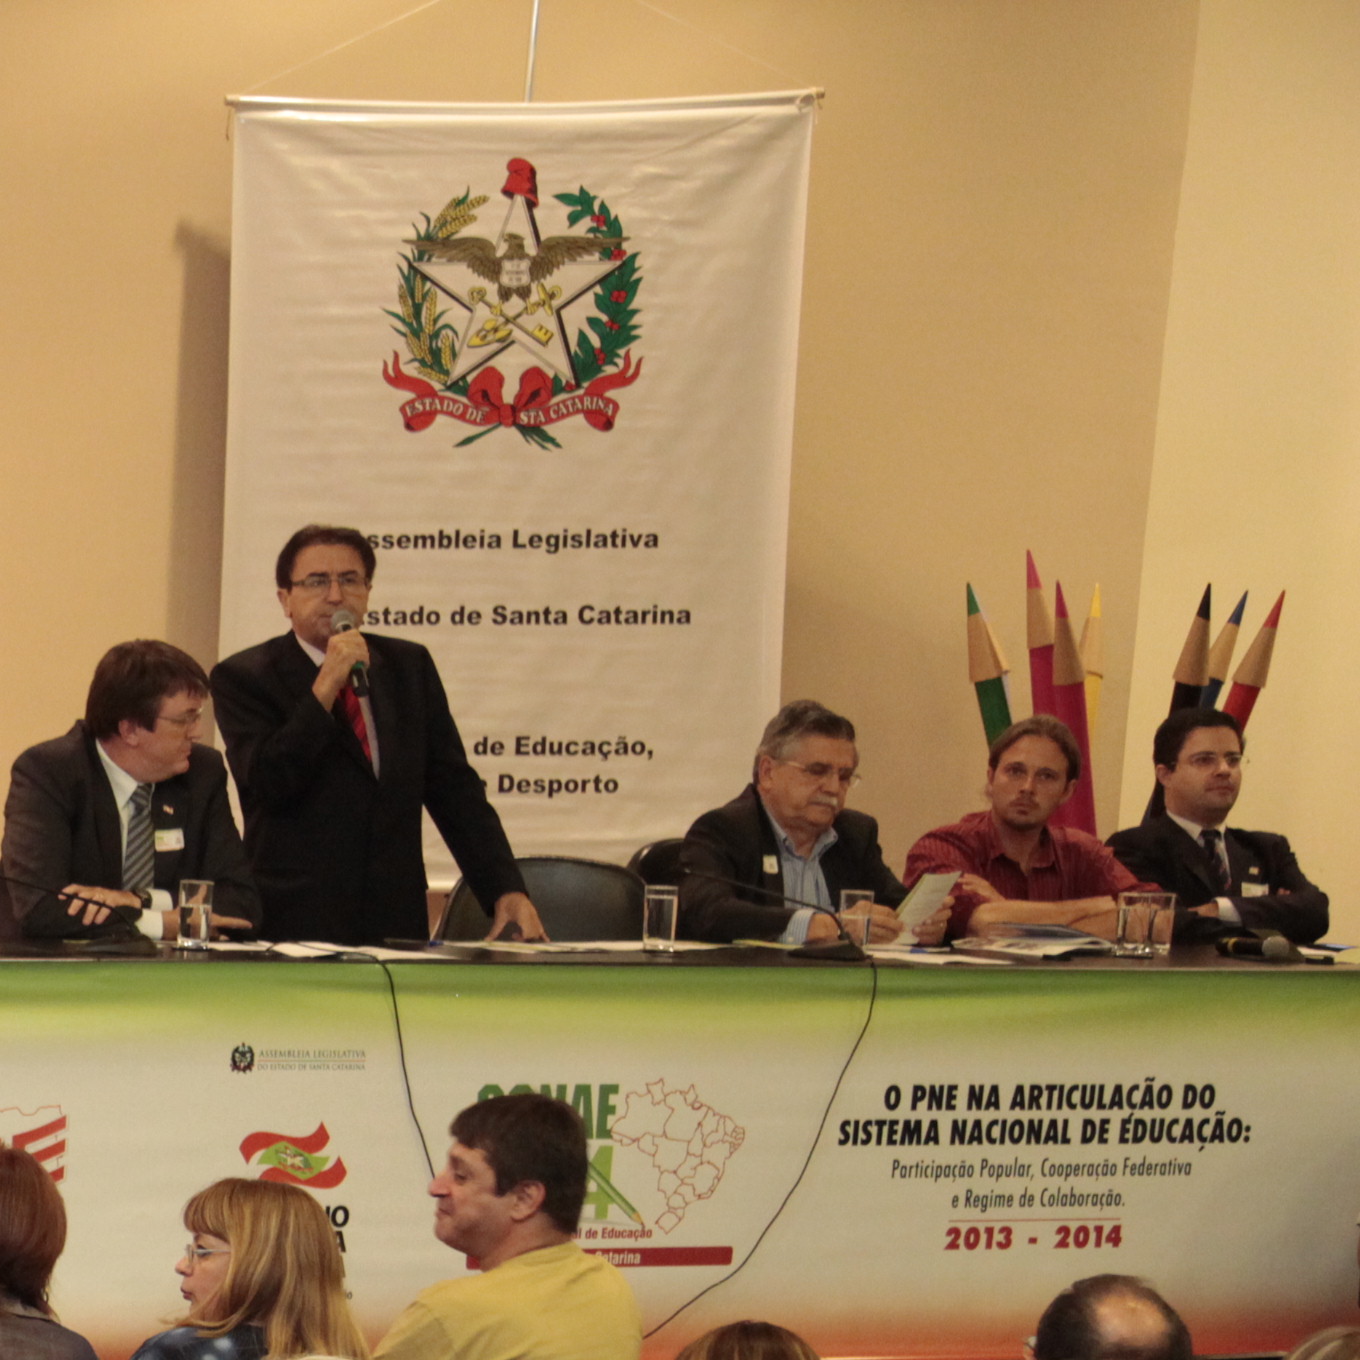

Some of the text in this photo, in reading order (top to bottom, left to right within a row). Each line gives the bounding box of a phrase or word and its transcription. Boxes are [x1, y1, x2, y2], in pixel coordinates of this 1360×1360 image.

[405, 398, 613, 424] ESTADO DE STA CATARINA
[368, 528, 659, 554] ssembleia Legislativa
[367, 605, 691, 626] stado de Santa Catarina
[473, 734, 654, 761] de Educação,
[498, 774, 619, 798] Desporto
[884, 1085, 901, 1111] O
[911, 1084, 958, 1111] PNE
[967, 1084, 1001, 1111] NA
[1182, 1084, 1216, 1109] DO
[838, 1110, 1251, 1152] SISTEMA NACIONAL DE EDUCAÇÃO:
[891, 1155, 1192, 1183] Participação Popular, Cooperação Federativa
[952, 1187, 1125, 1213] e Regime de Colaboração.
[585, 1228, 597, 1238] de
[601, 1227, 652, 1241] Educação
[945, 1226, 1013, 1250] 2013
[1054, 1225, 1122, 1249] 2014
